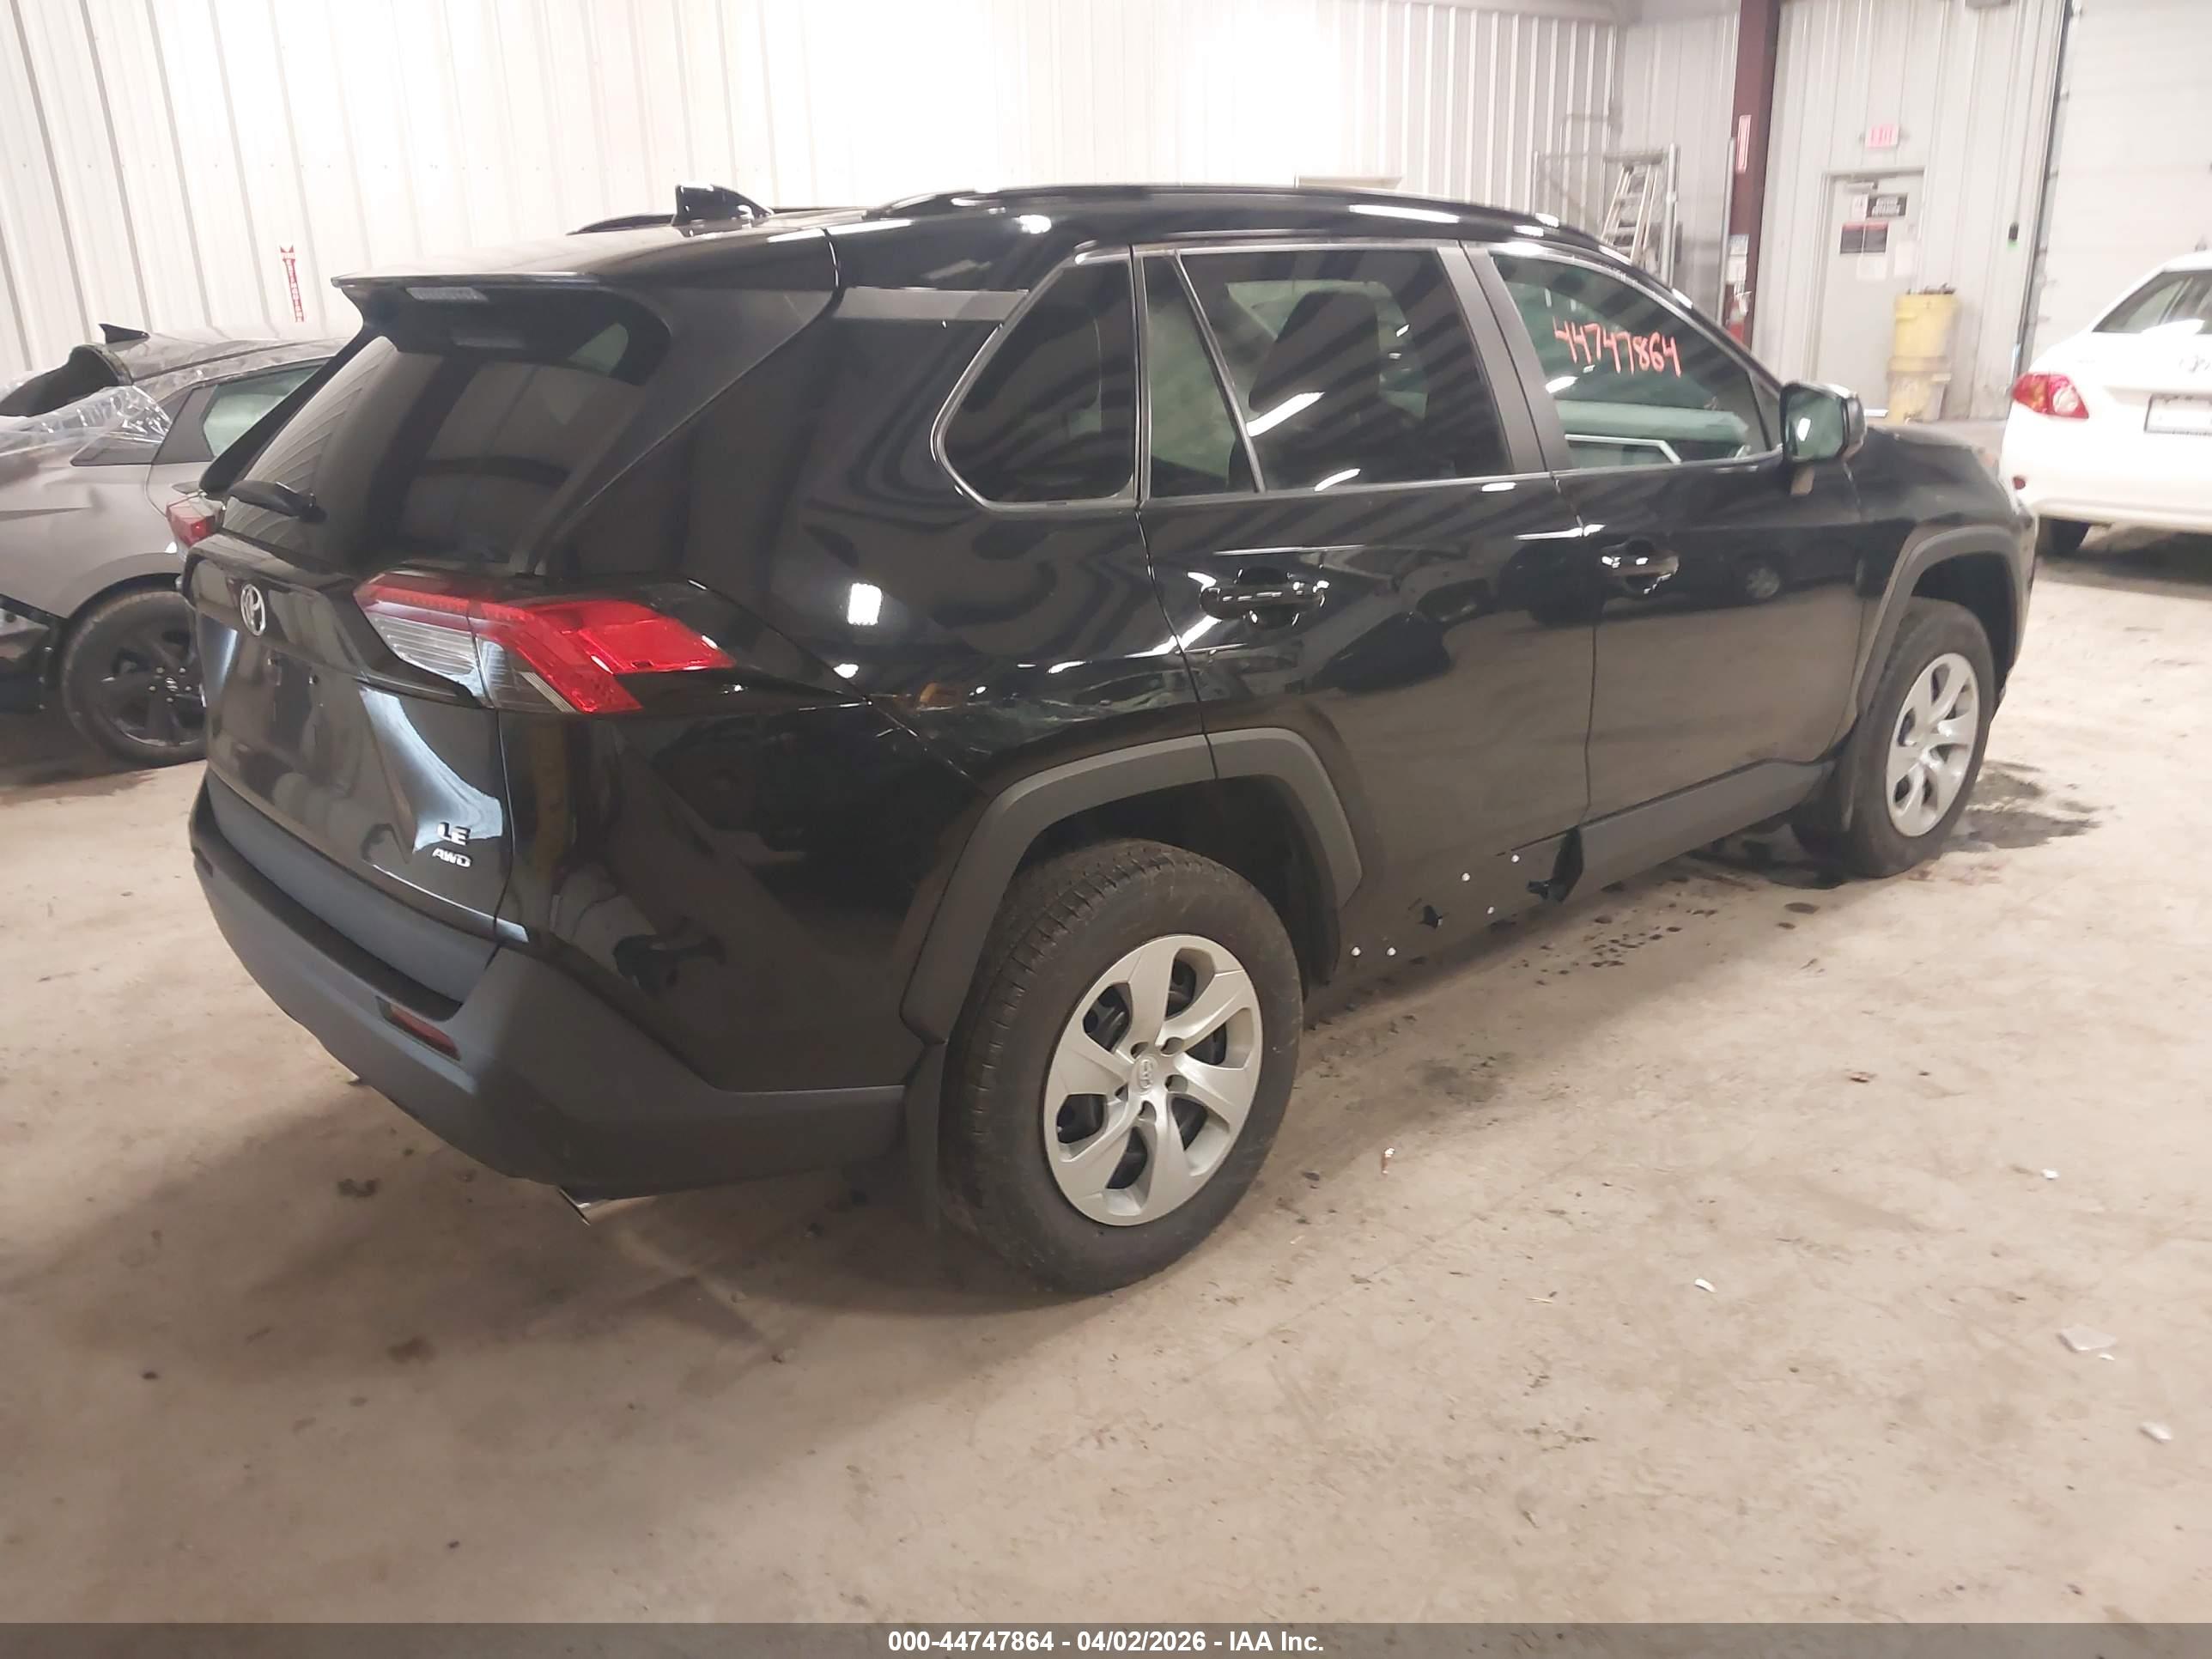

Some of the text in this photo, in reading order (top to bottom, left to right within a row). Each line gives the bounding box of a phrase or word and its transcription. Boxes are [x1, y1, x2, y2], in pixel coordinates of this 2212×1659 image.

[1553, 316, 1681, 378] 44747864
[437, 822, 471, 846] LE
[431, 848, 471, 868] AWD
